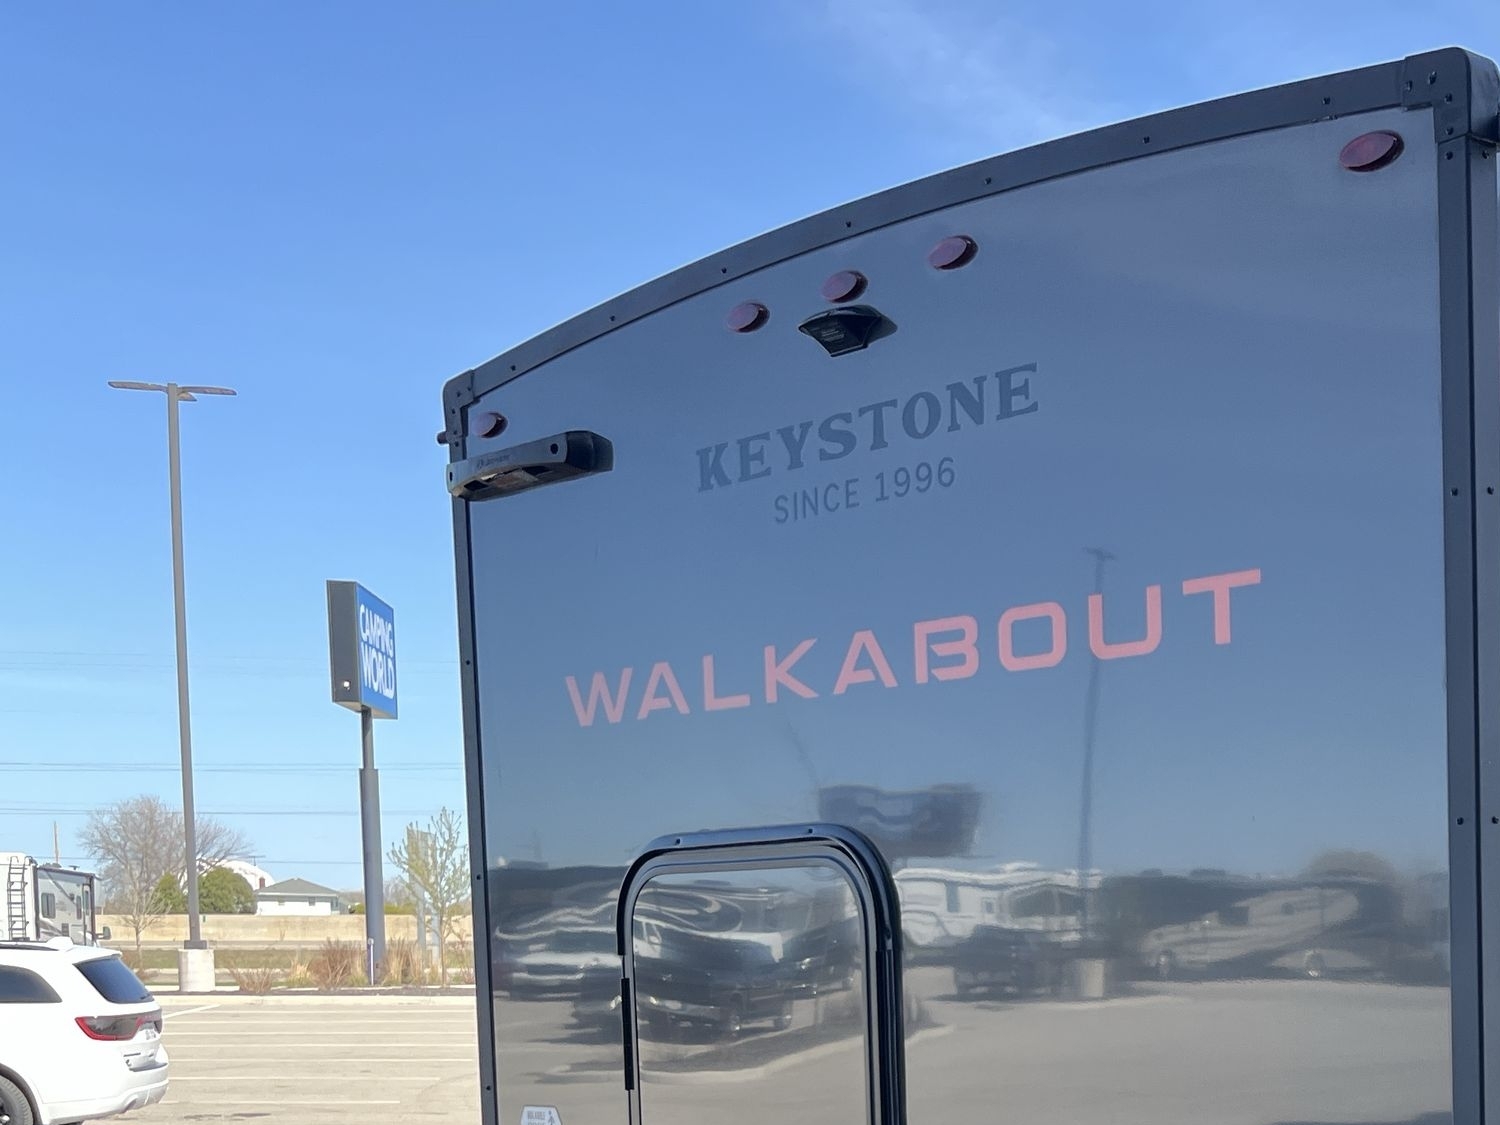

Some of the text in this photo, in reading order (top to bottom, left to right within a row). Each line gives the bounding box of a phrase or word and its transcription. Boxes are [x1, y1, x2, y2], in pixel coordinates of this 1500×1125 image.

[696, 362, 1040, 493] KEYSTONE
[774, 457, 956, 525] SINCE 1996
[359, 603, 394, 658] CAMPING
[565, 568, 1262, 728] WALKABOUT
[360, 641, 396, 700] WORLD
